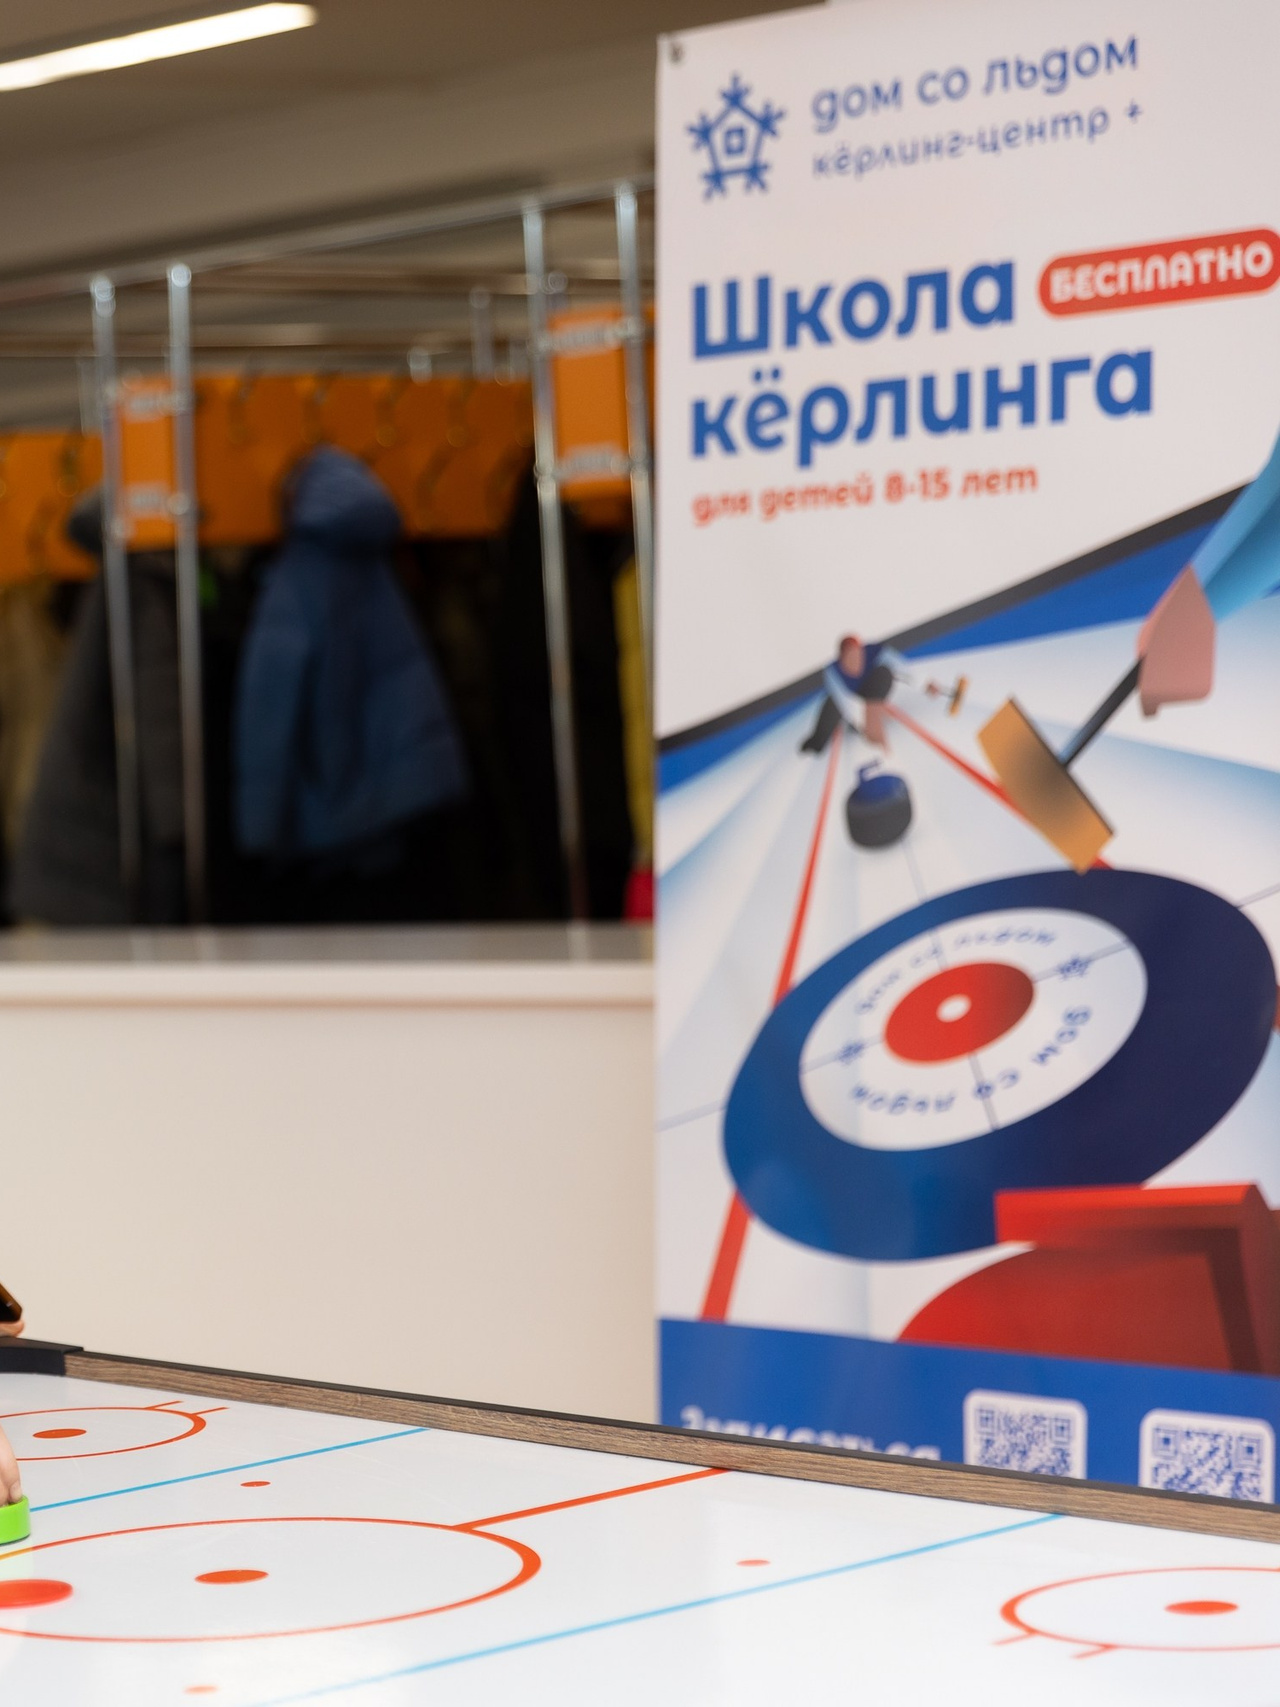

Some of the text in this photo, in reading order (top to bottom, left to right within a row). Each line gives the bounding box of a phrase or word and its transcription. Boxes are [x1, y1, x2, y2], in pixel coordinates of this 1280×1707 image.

[812, 36, 1139, 133] дом со льдом
[813, 107, 1109, 179] кёрлинг-центр
[693, 260, 1015, 359] Школа
[1048, 241, 1273, 303] БЕСПЛАТНО
[692, 349, 1153, 468] кёрлинга
[692, 466, 1039, 527] для детей 8-15 лет
